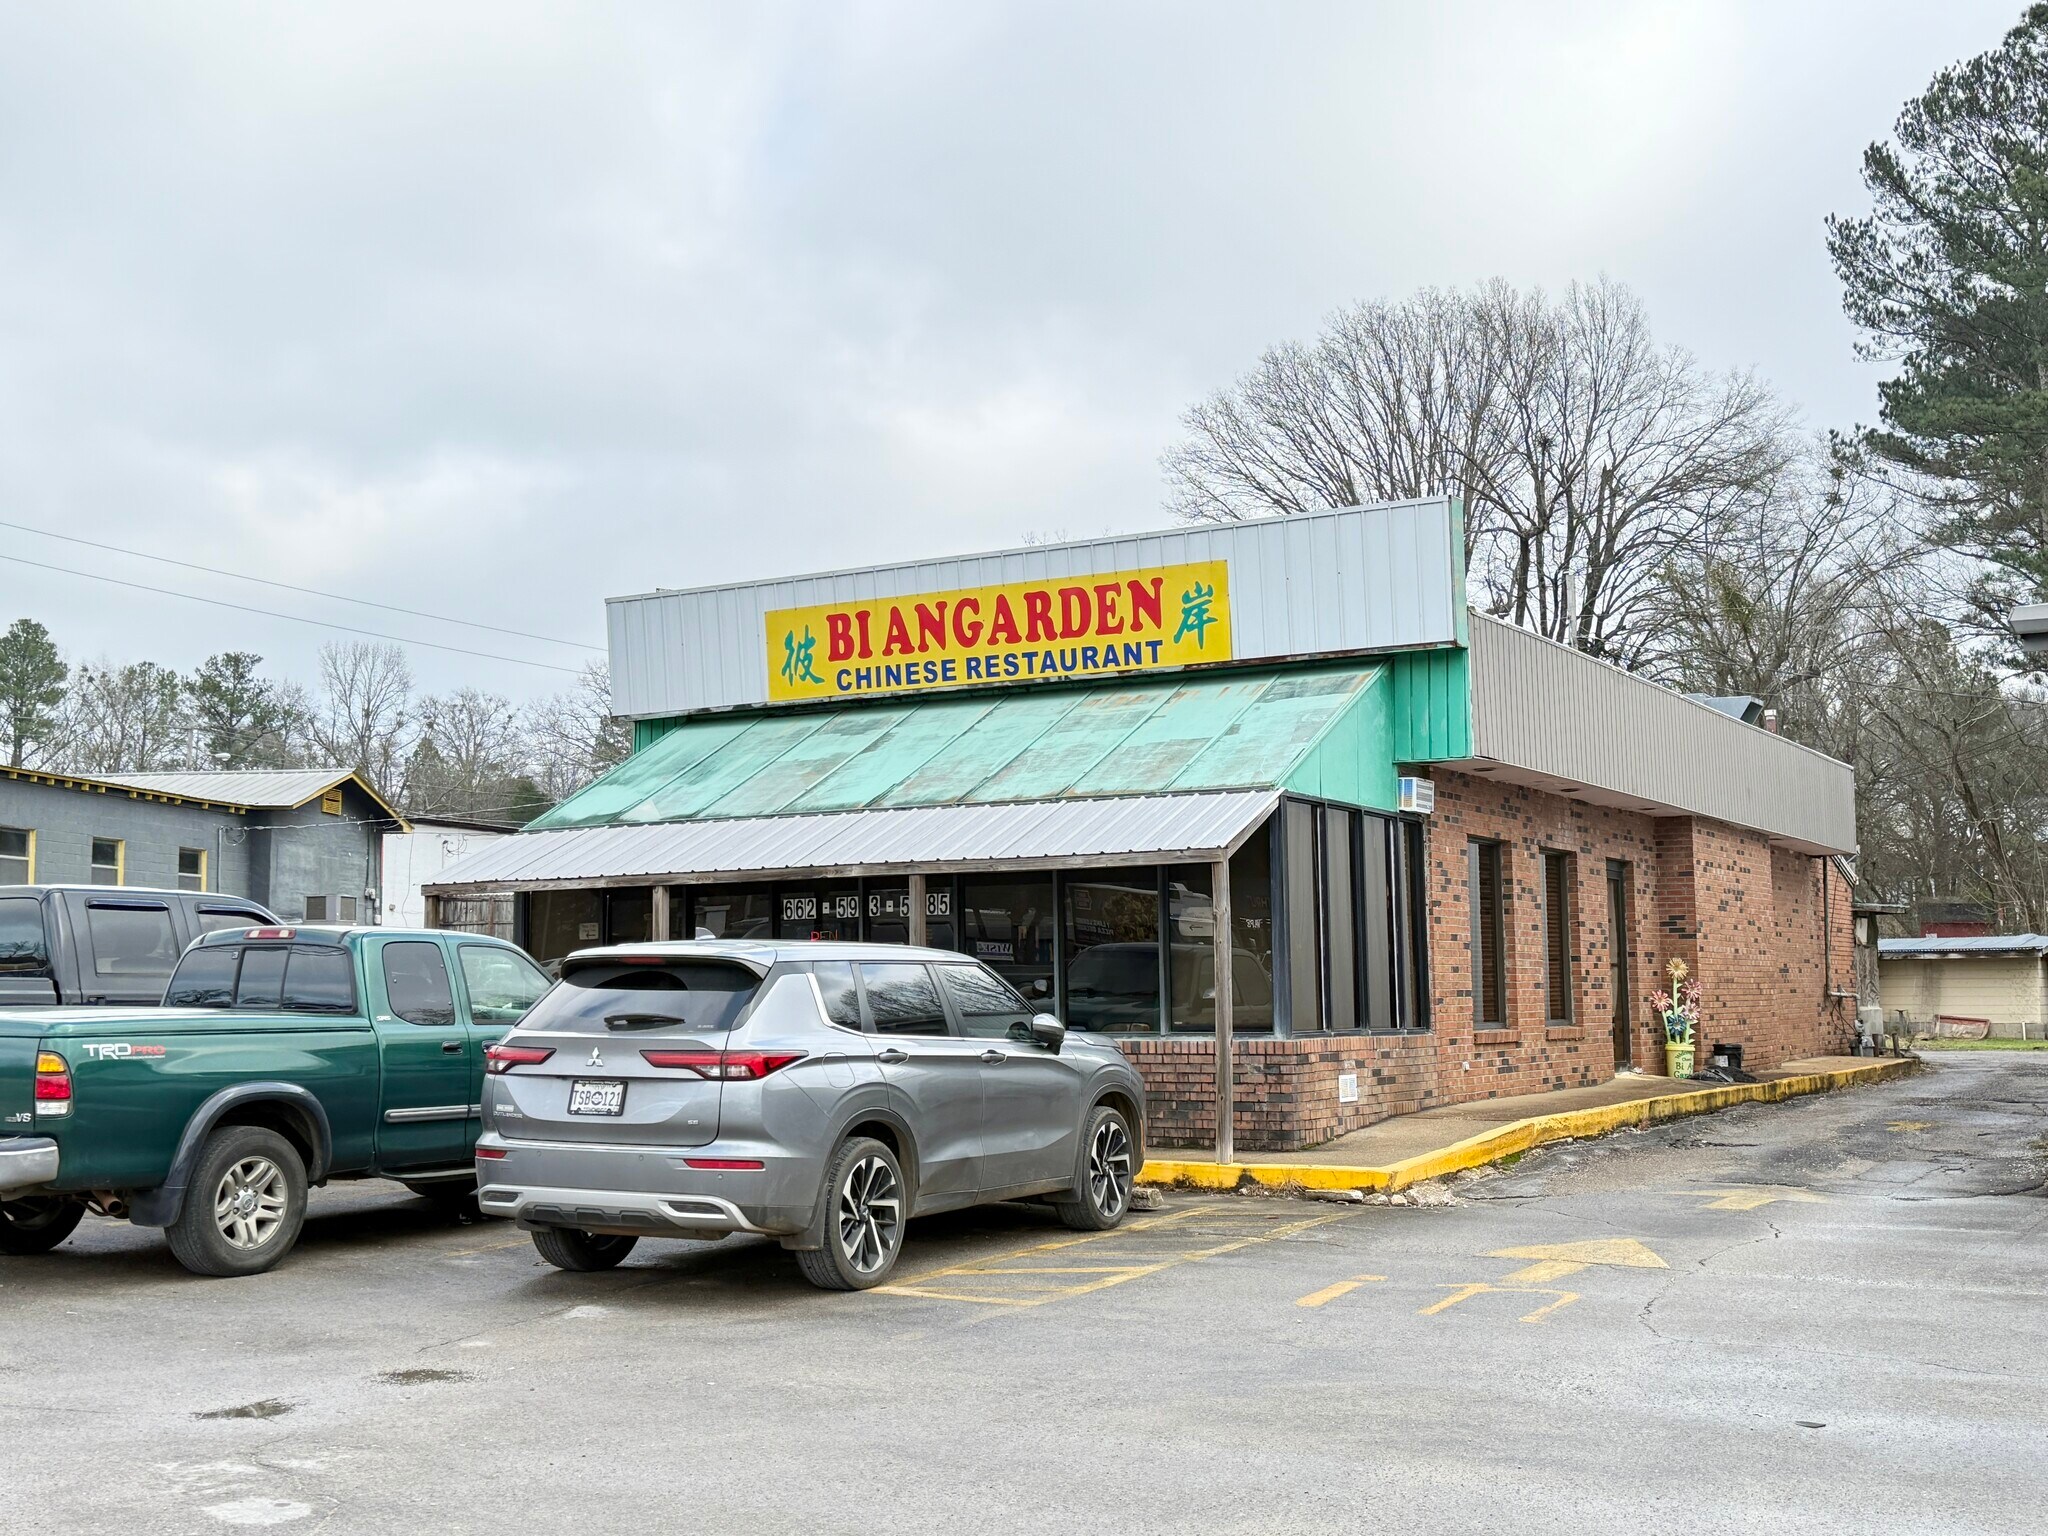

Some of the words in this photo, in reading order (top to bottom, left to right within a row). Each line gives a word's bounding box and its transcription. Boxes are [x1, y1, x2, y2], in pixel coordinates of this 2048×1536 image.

[826, 610, 873, 662] BI
[1173, 581, 1218, 649] 岸
[781, 624, 825, 687] 彼
[836, 658, 957, 691] CHINESE
[965, 640, 1163, 680] RESTAURANT
[82, 1043, 131, 1060] TRD
[131, 1045, 166, 1056] PRO
[1675, 1062, 1684, 1070] Bi
[573, 1090, 592, 1105] TSB
[602, 1091, 621, 1107] 121
